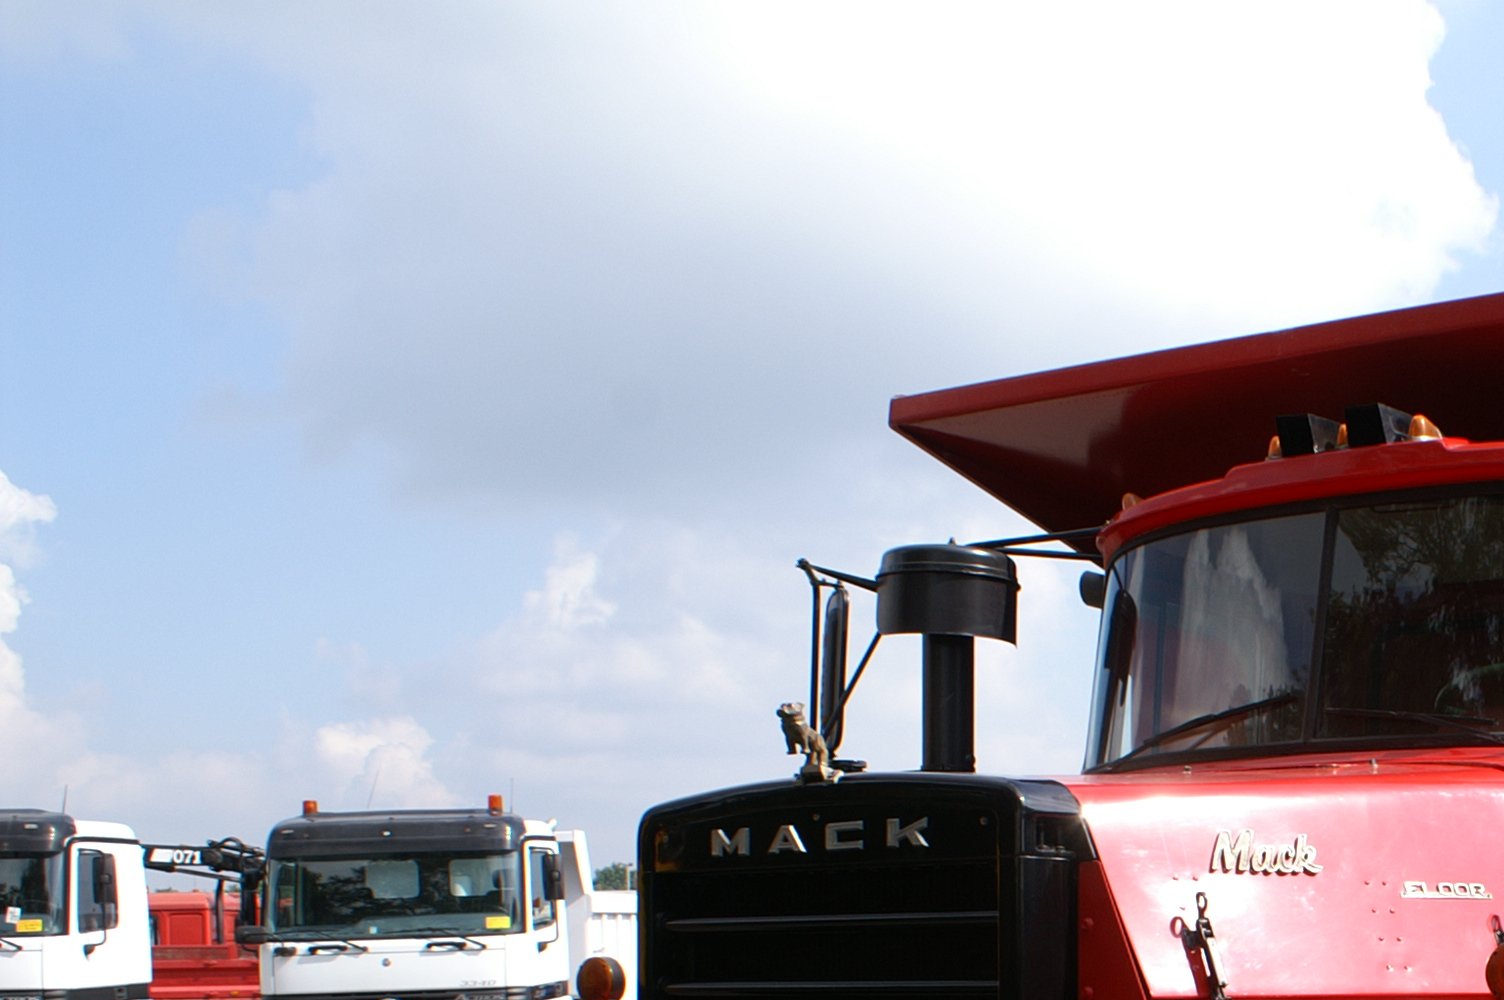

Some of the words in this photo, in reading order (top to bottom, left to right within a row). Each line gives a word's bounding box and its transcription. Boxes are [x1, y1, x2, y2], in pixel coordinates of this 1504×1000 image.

[710, 816, 930, 856] MACK
[1208, 829, 1324, 876] Mack
[173, 849, 202, 864] 071
